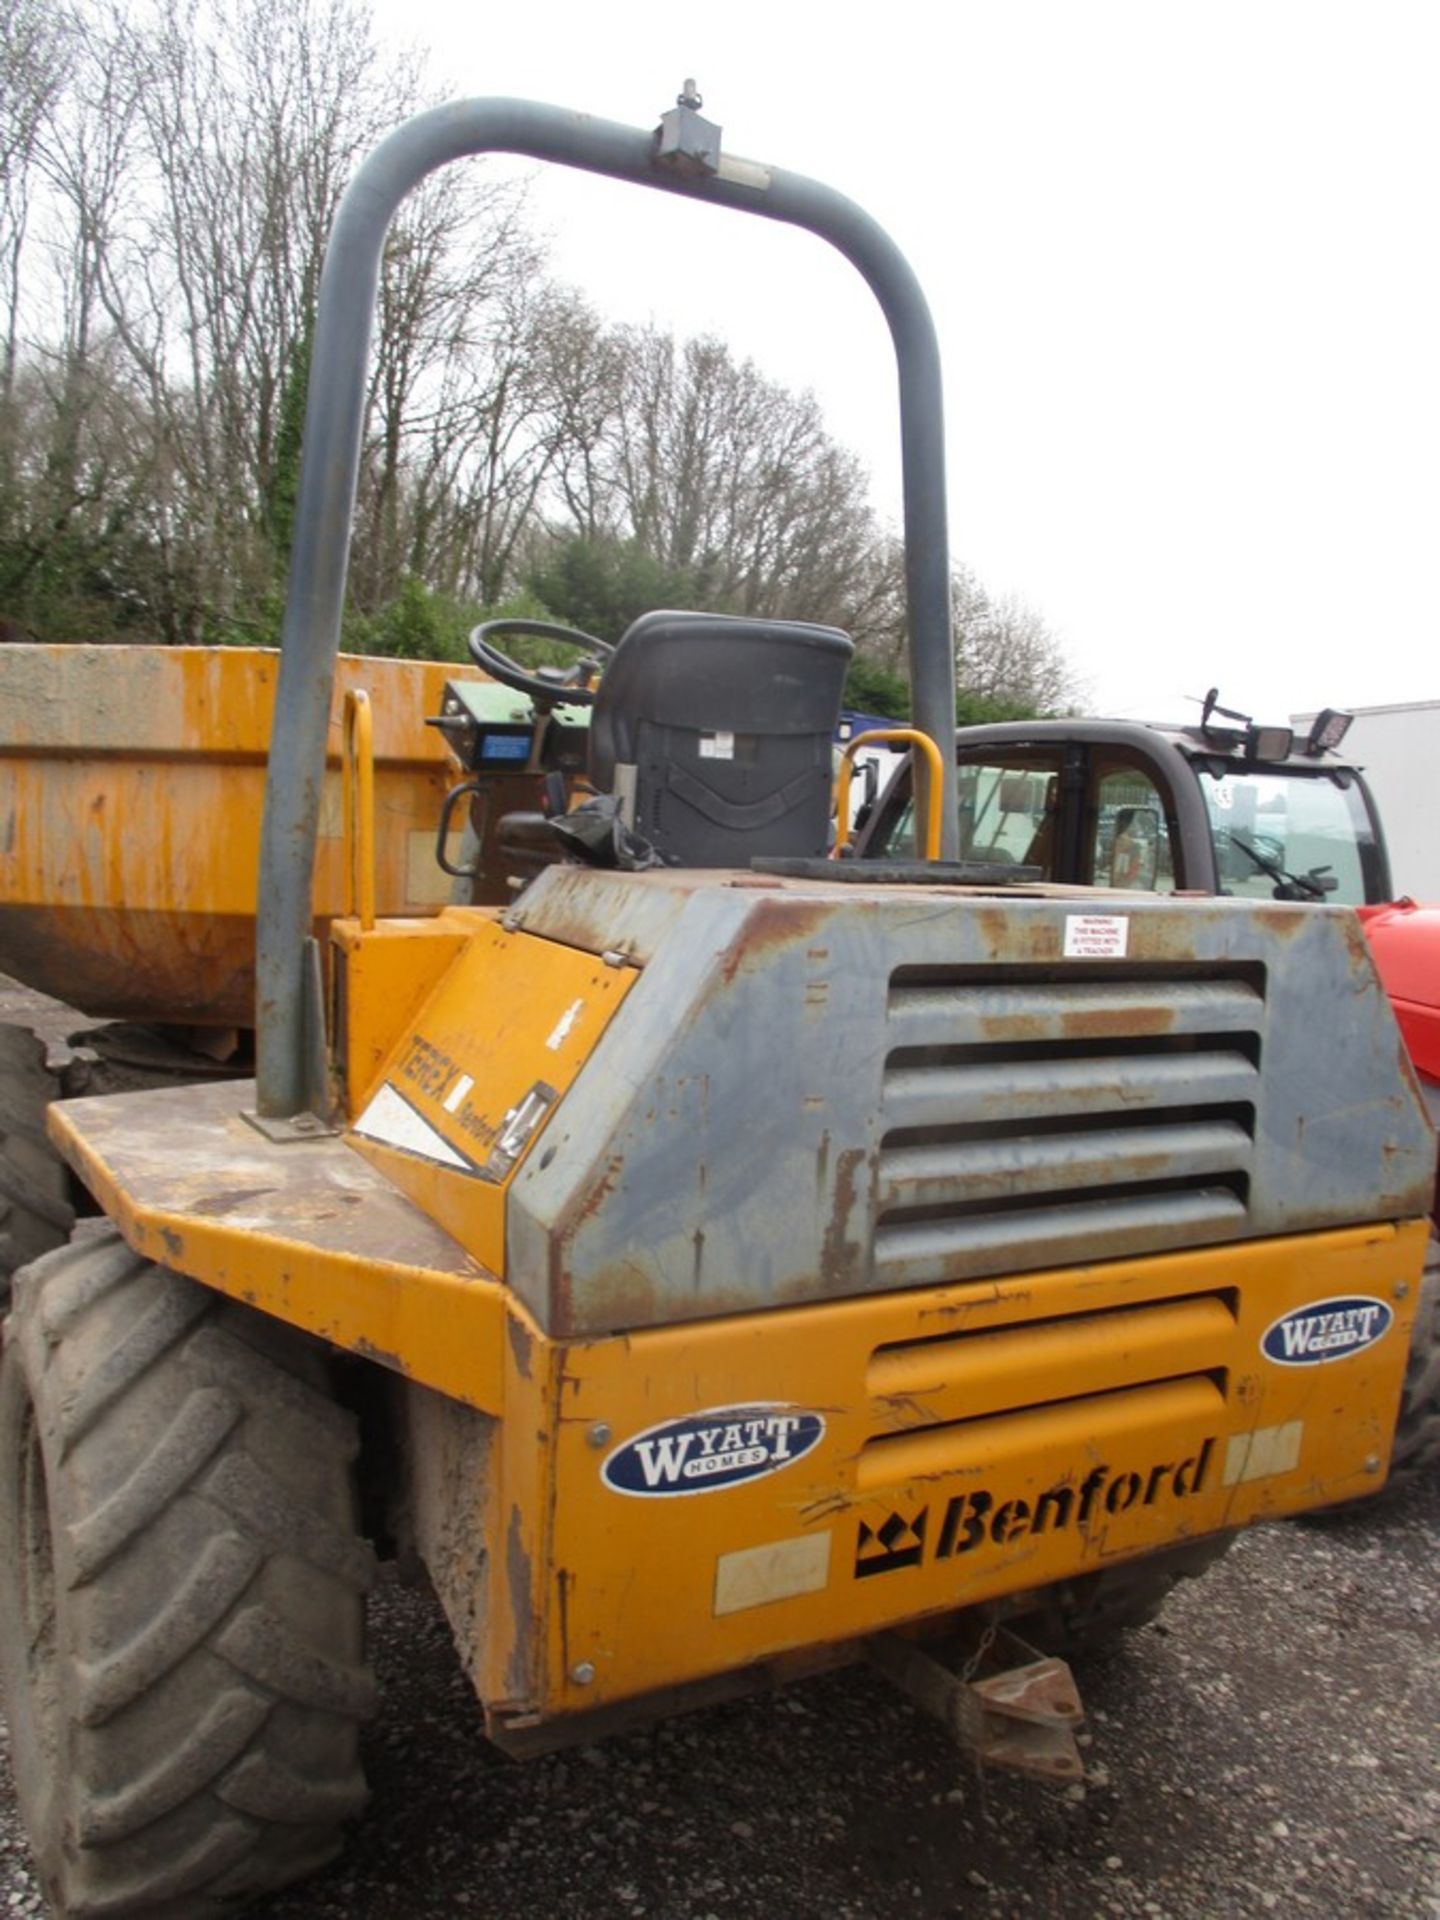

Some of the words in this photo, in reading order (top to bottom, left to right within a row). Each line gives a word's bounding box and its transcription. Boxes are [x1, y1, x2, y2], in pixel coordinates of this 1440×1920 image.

[399, 1034, 461, 1102] TEREX
[1281, 1305, 1379, 1357] WYATT
[633, 1416, 799, 1487] WYATT
[690, 1449, 761, 1474] HOMES
[935, 1437, 1215, 1559] Benford
